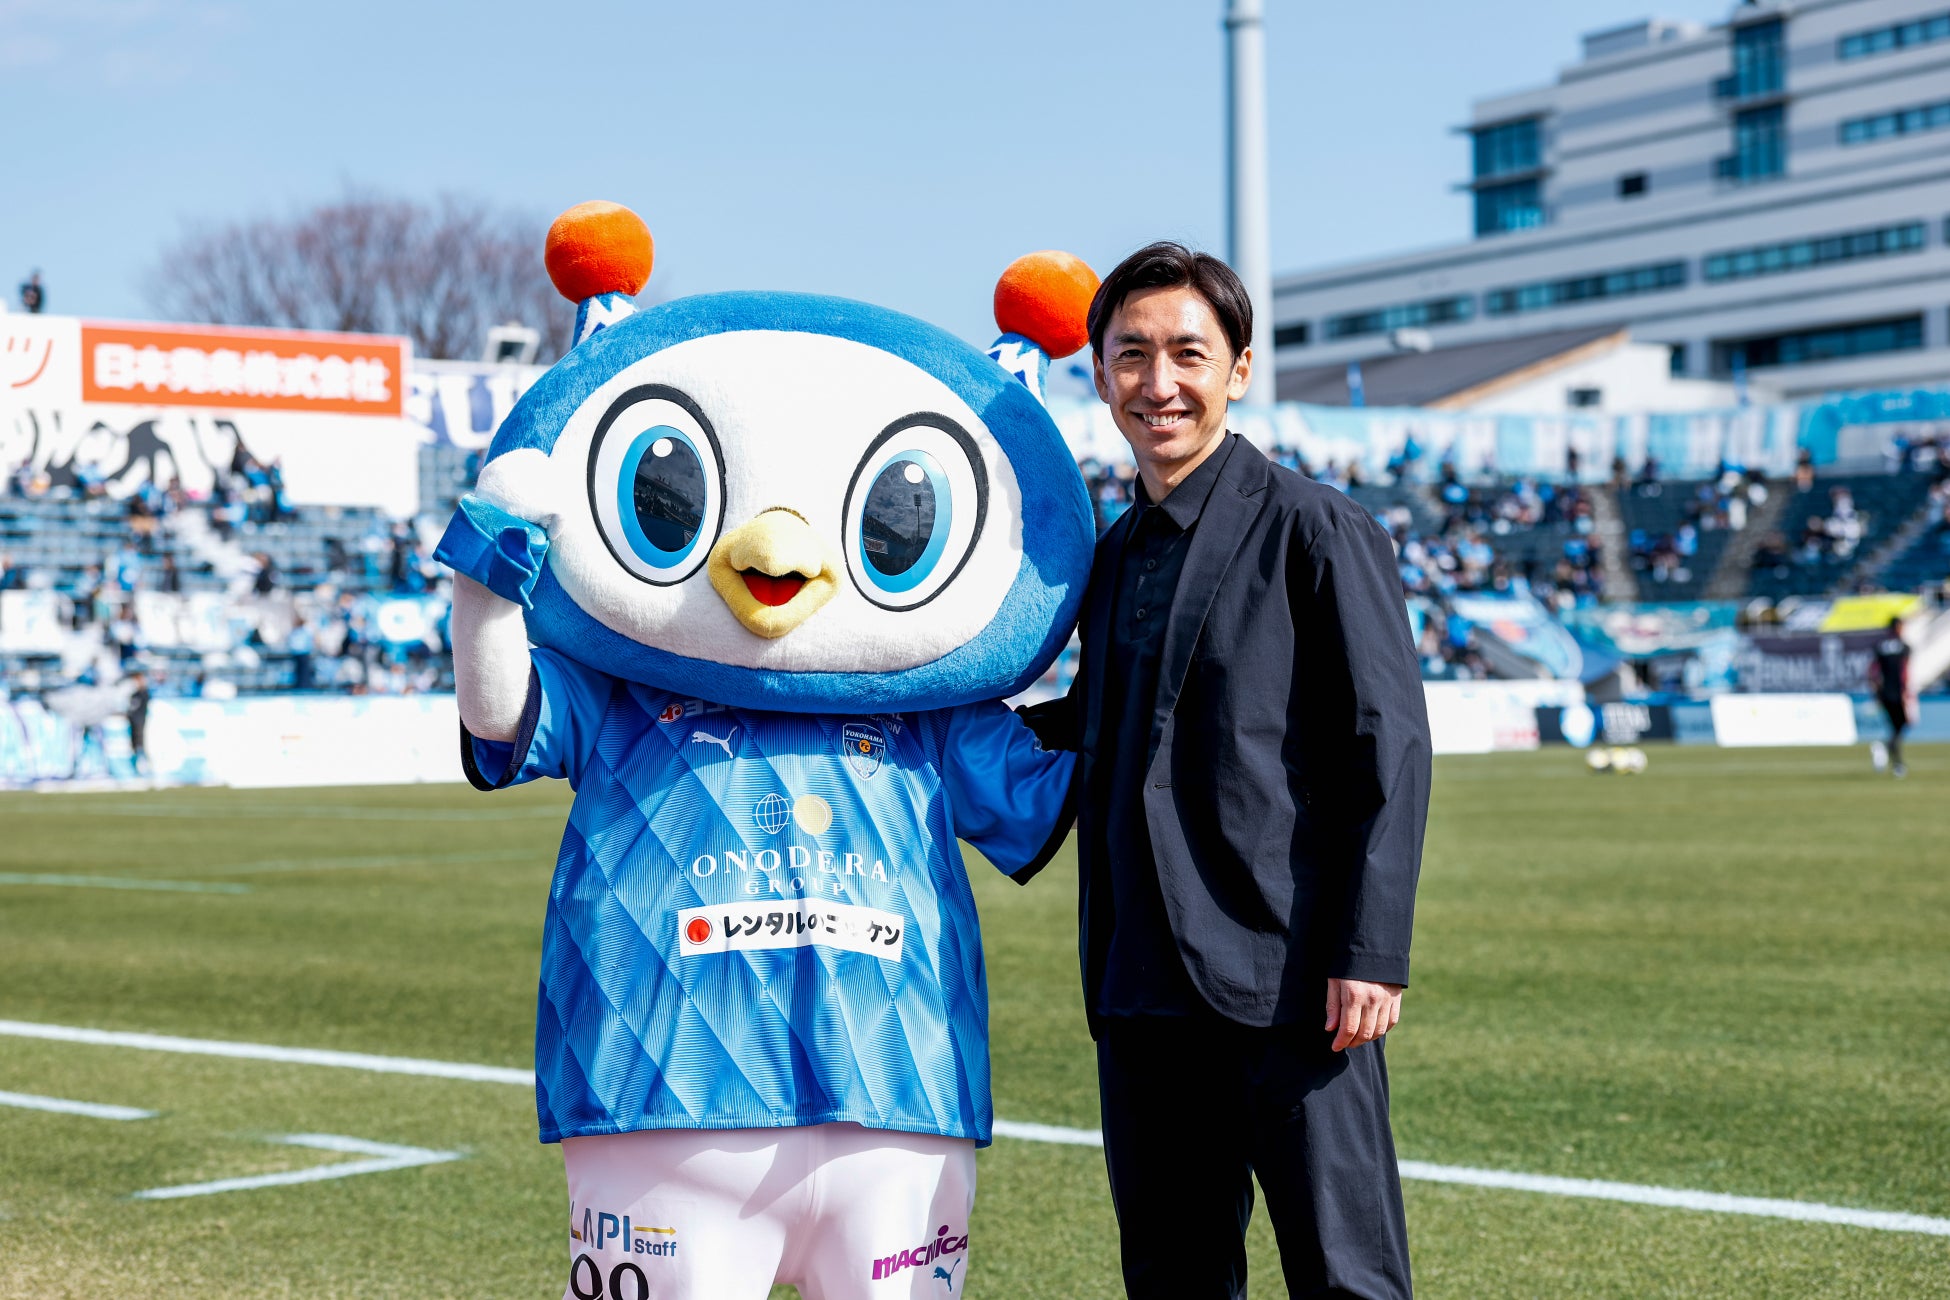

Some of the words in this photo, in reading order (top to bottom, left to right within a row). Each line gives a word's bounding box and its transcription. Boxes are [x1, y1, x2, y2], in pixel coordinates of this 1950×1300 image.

[845, 730, 883, 744] YOKOHAMA
[692, 846, 888, 883] ONODERA
[745, 877, 845, 896] GROUP
[724, 912, 900, 945] レンタルのニケン
[634, 1238, 677, 1256] Staff
